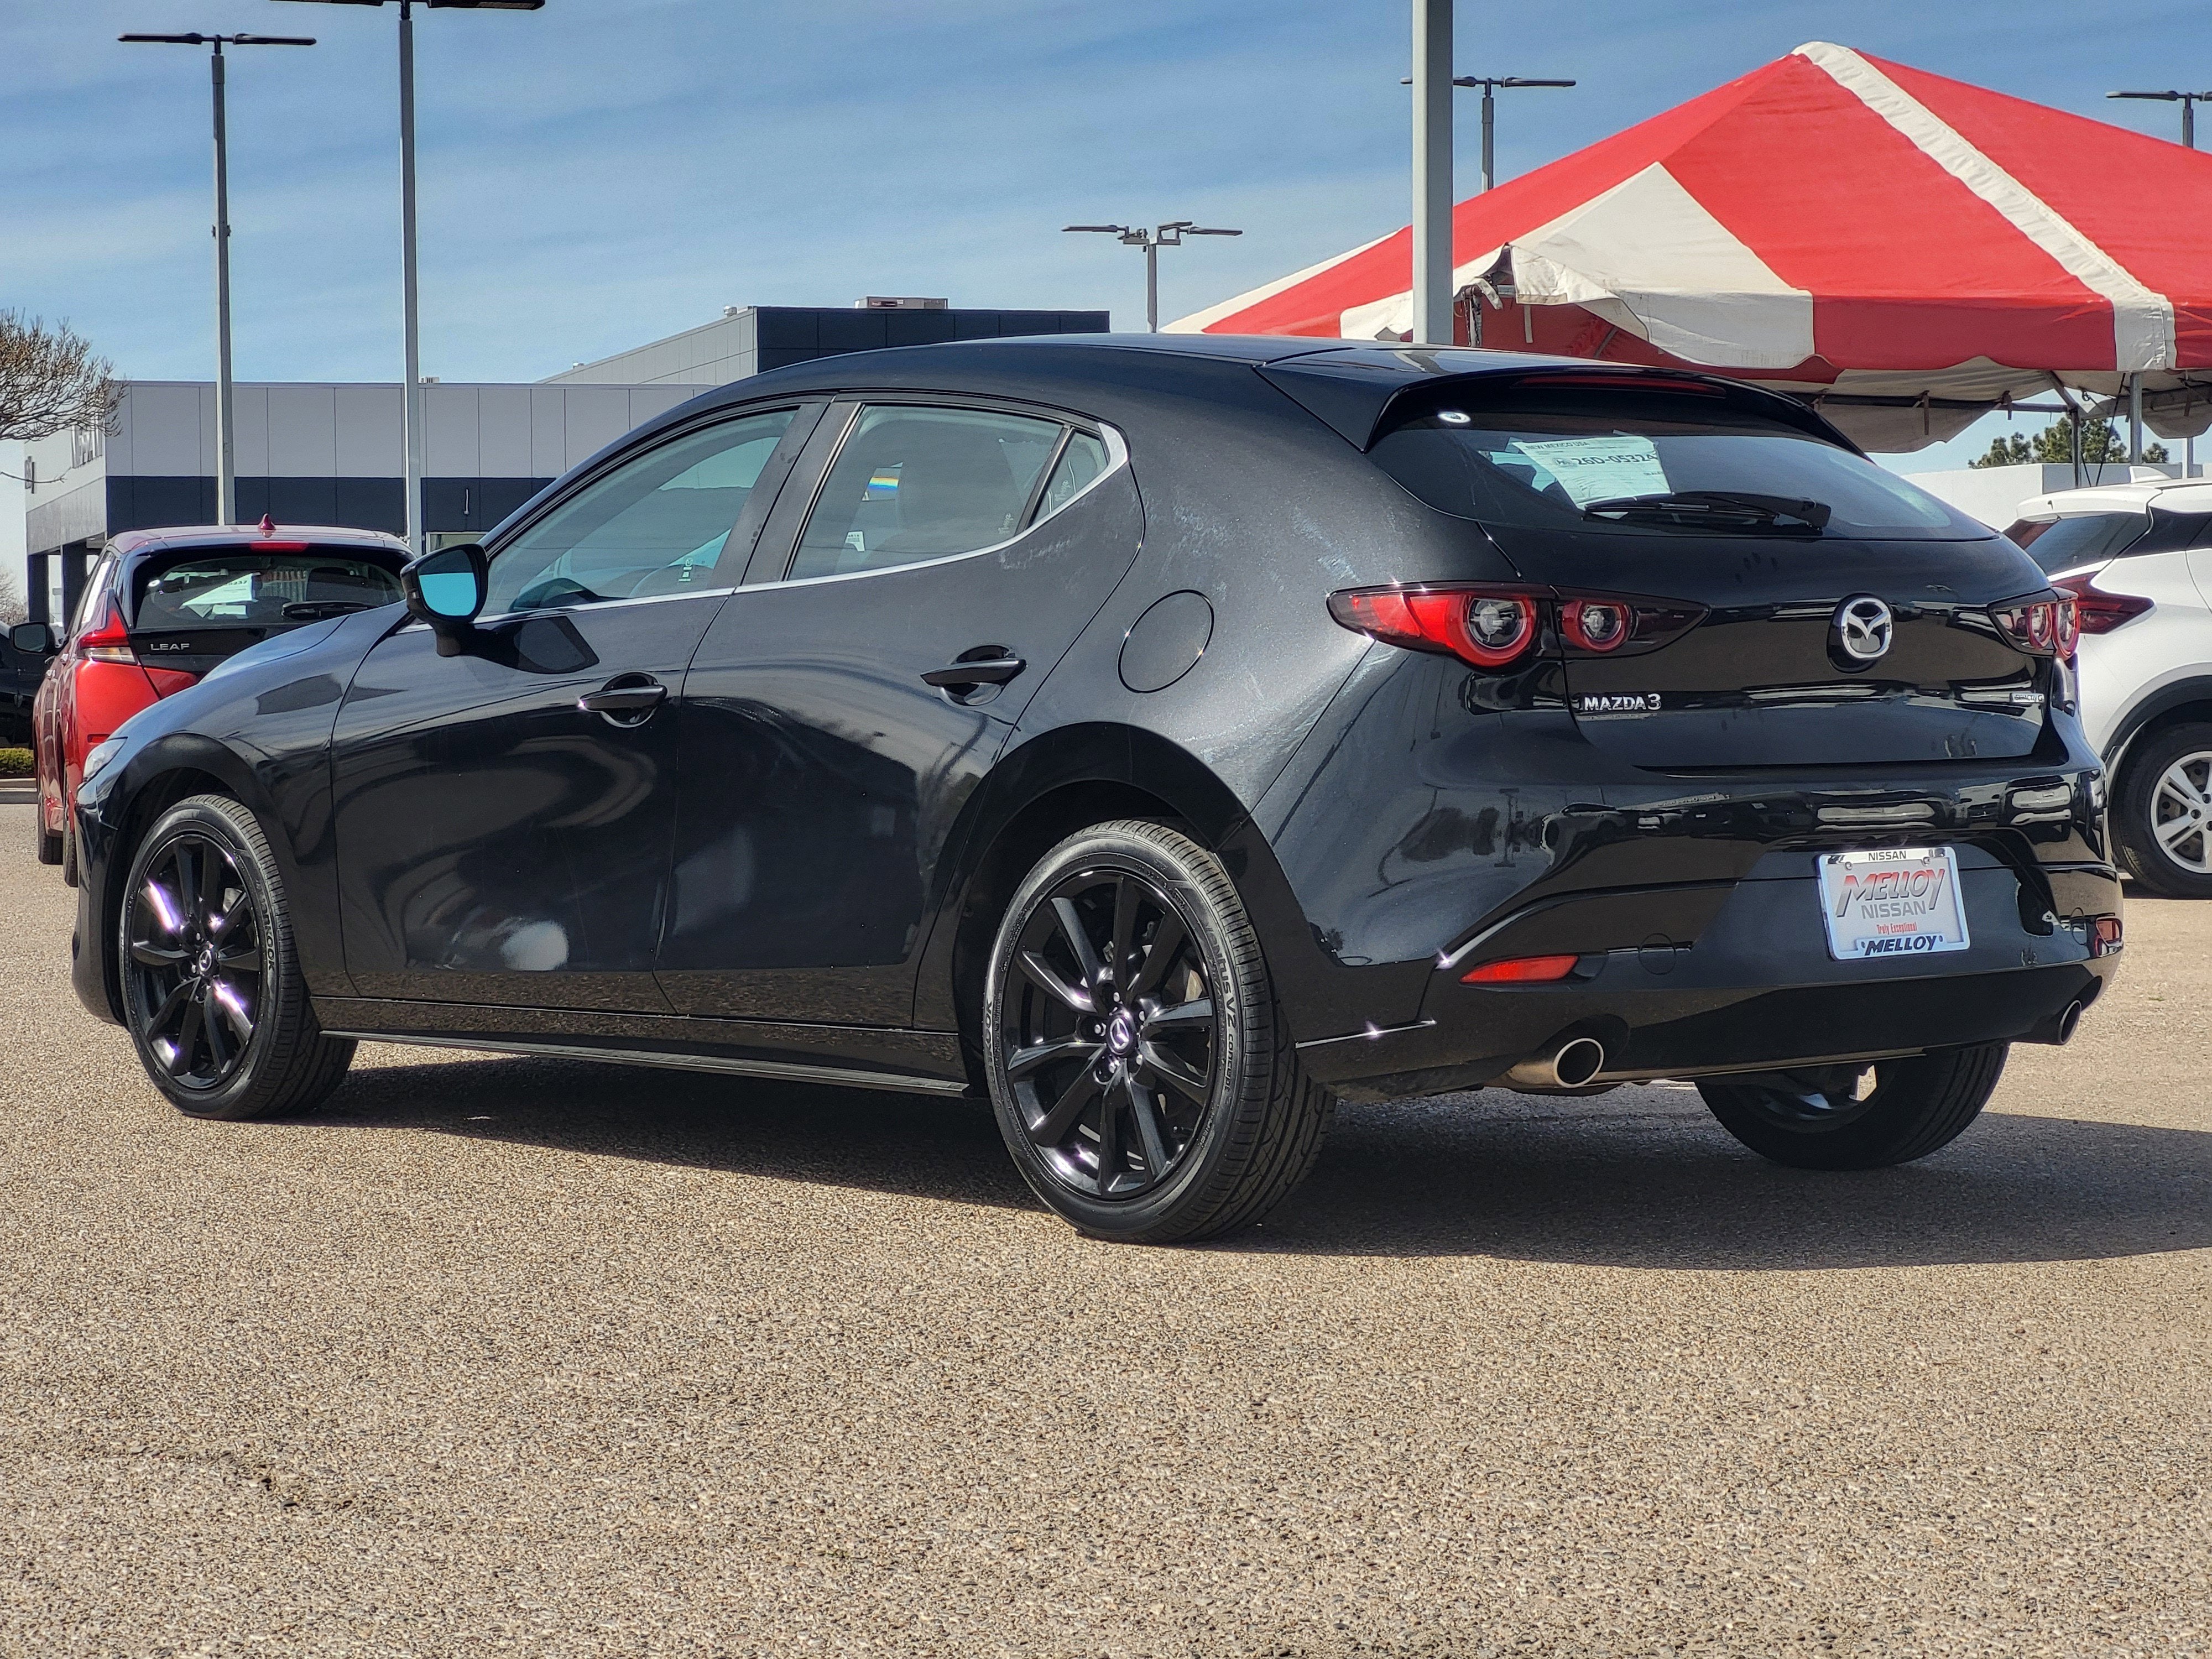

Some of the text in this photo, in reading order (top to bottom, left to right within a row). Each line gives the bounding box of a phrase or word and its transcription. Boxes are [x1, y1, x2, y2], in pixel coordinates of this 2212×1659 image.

[1584, 693, 1661, 711] MAZDA3
[1868, 851, 1906, 861] NISSAN
[1835, 869, 1945, 917] MELLOY
[1861, 900, 1926, 919] NISSAN
[1876, 922, 1917, 935] Truly Exceptional
[1864, 935, 1937, 956] MELLOY
